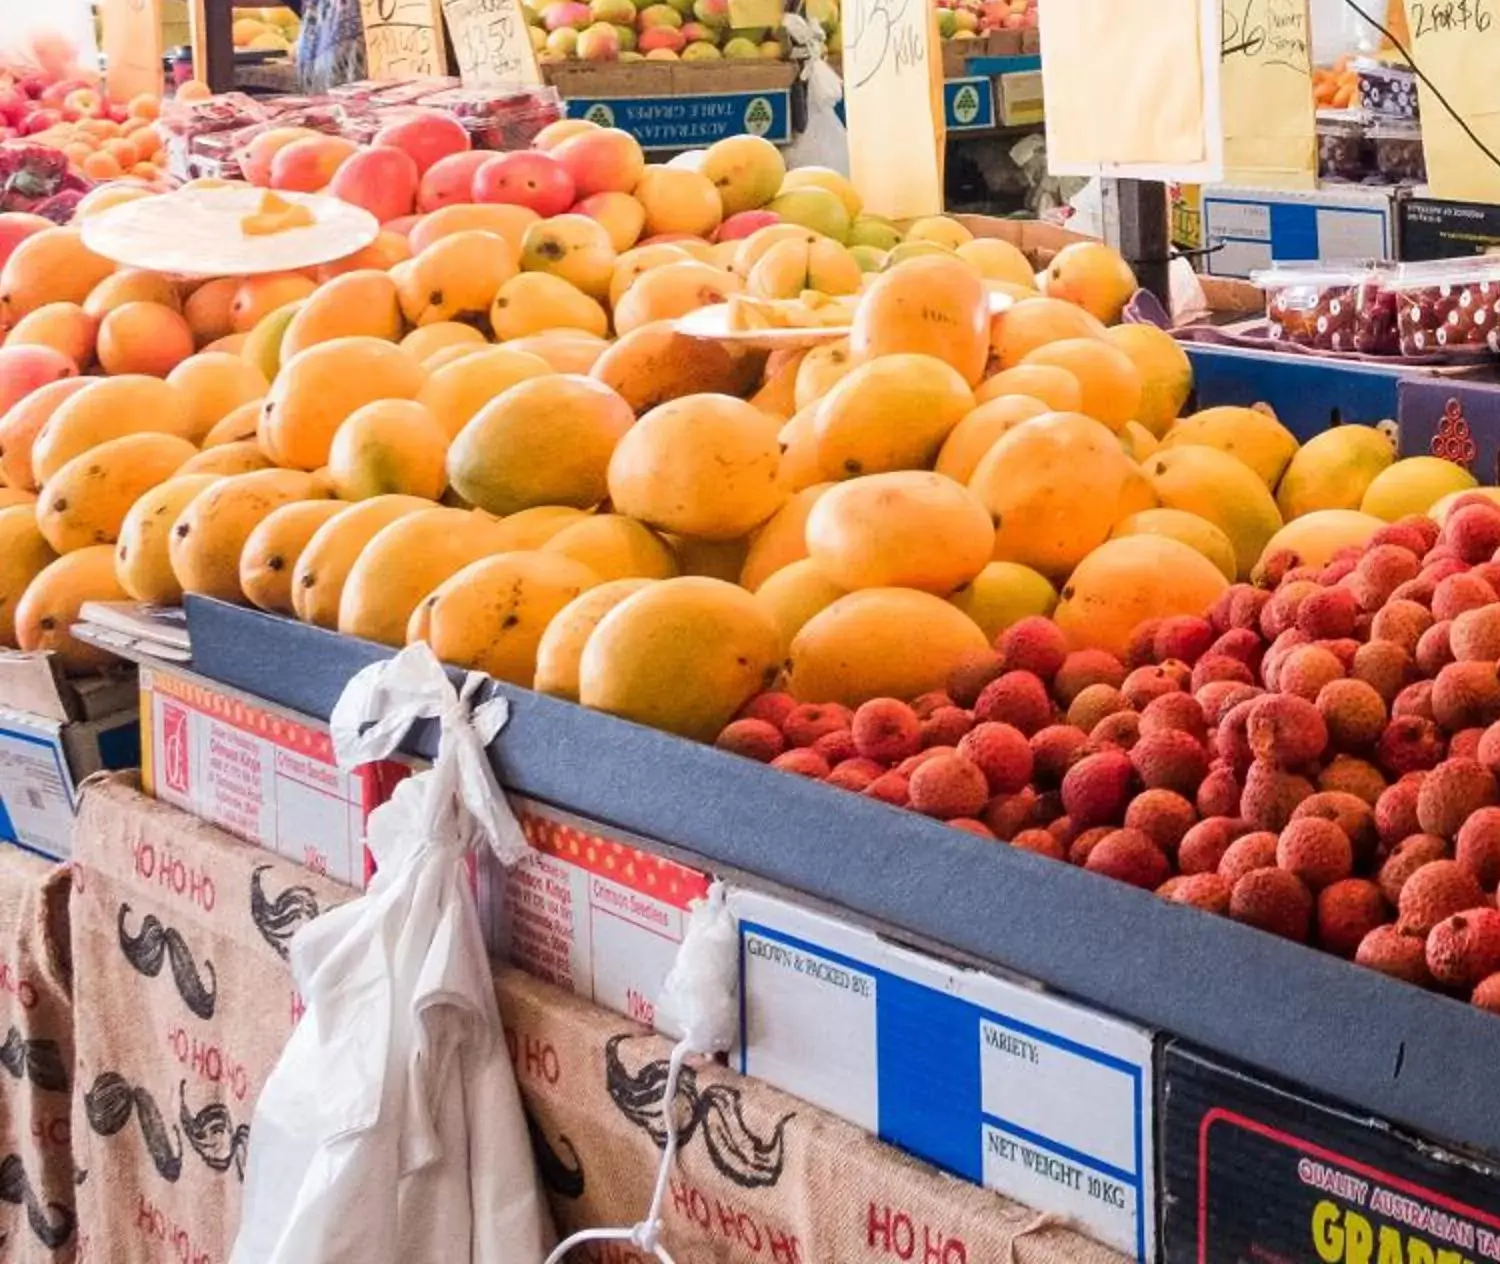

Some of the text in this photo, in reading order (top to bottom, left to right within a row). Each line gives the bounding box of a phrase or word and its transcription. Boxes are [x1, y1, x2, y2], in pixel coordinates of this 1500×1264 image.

[1411, 3, 1433, 38] 2
[159, 853, 188, 894] HO
[747, 936, 871, 998] GROWN & PACKED BY:
[290, 991, 306, 1025] H
[191, 1042, 223, 1082] HO
[525, 1037, 559, 1085] HO
[983, 1024, 1040, 1064] VARIETY:
[988, 1131, 1020, 1161] NET
[1021, 1146, 1083, 1191] WEIGHT
[670, 1179, 712, 1229] HO
[716, 1202, 762, 1252] HO
[1298, 1158, 1369, 1206] QUALITY
[1371, 1187, 1473, 1249] AUSTRALIAN
[866, 1201, 917, 1260] HO
